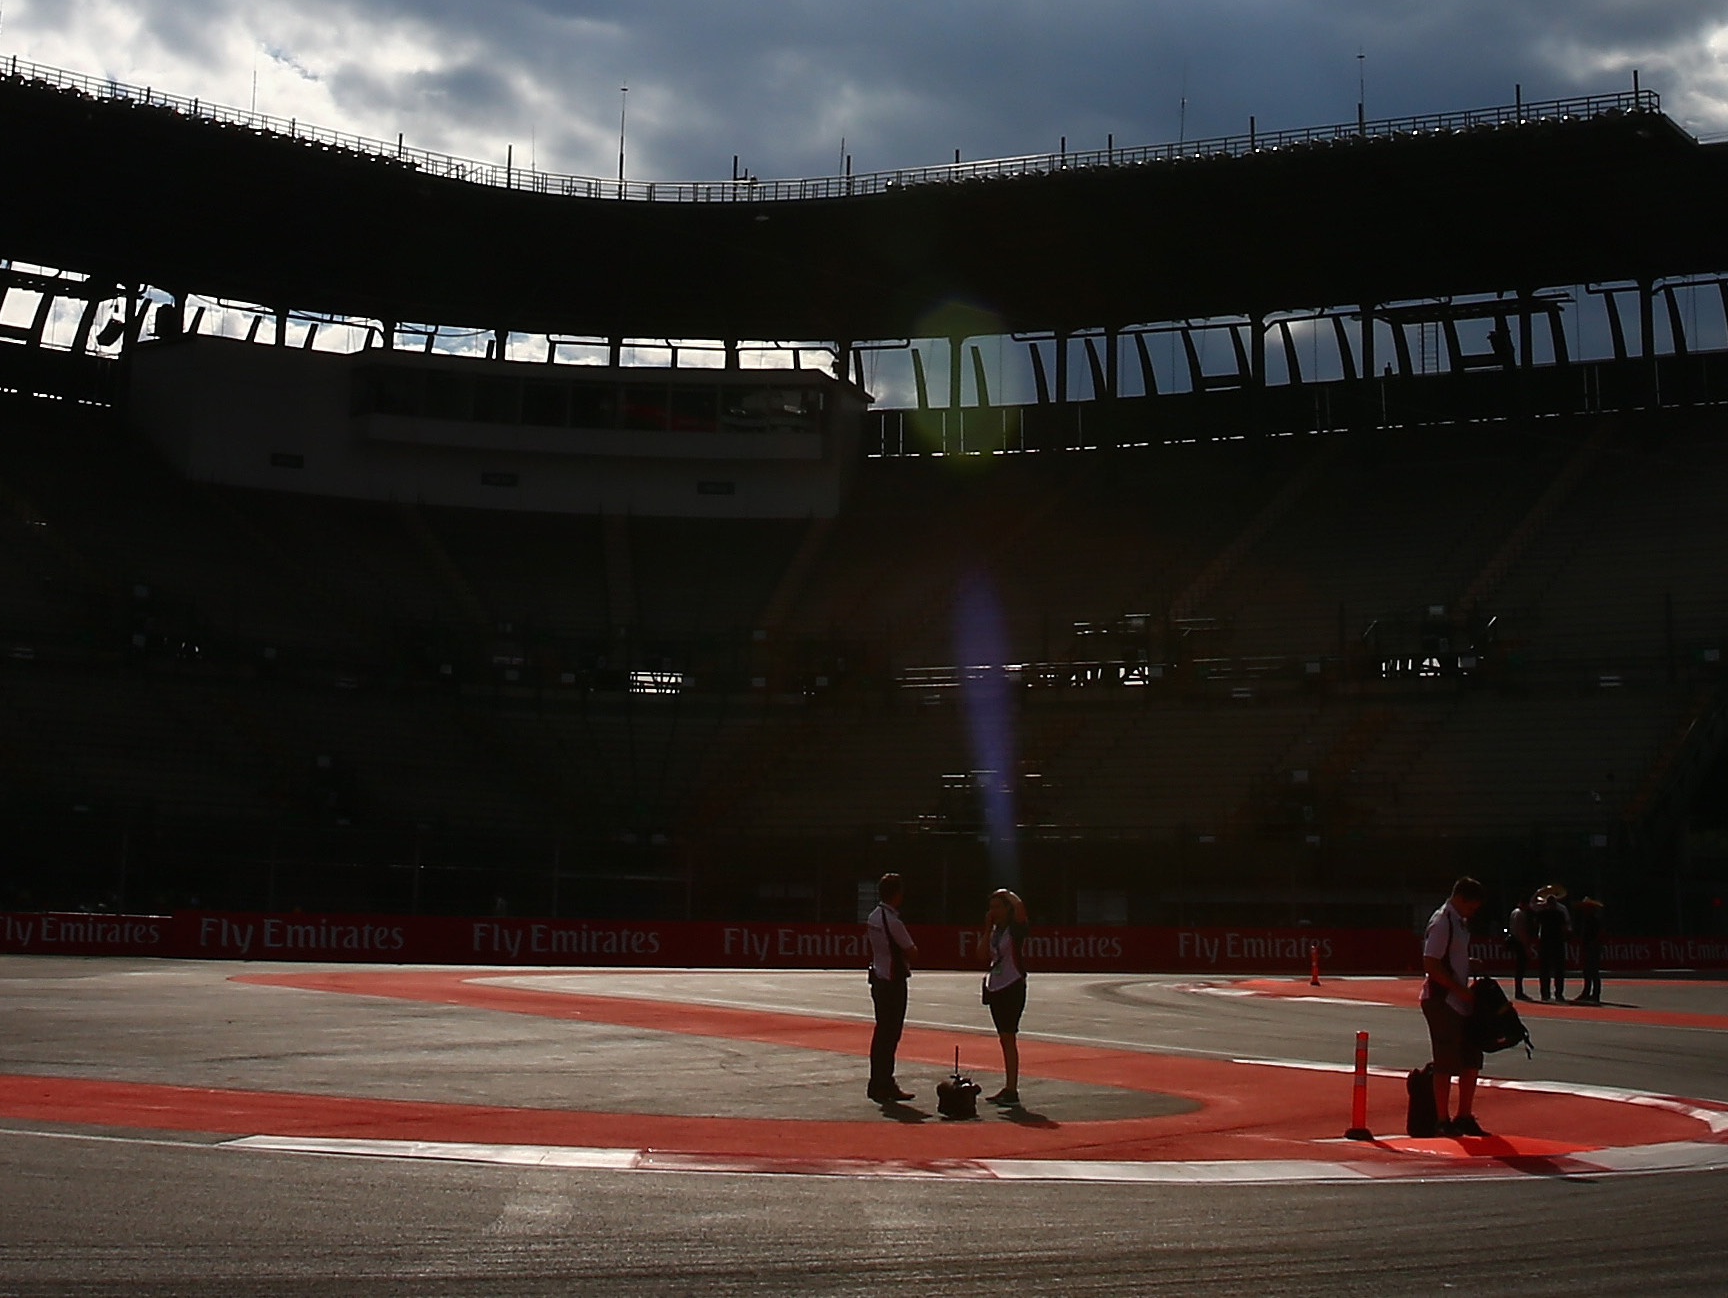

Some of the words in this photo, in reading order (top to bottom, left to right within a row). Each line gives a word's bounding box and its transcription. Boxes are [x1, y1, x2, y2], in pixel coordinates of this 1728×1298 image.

[41, 916, 161, 943] Emirates
[200, 917, 254, 954] Fly
[263, 918, 405, 950] Emirates
[473, 923, 522, 958] Fly
[530, 924, 660, 953] Emirates
[1022, 930, 1122, 958] mirates
[723, 928, 770, 962] Fly
[777, 928, 872, 956] Emirat
[1177, 931, 1219, 964] Fly
[1563, 941, 1581, 964] ly
[1660, 940, 1684, 962] Fly
